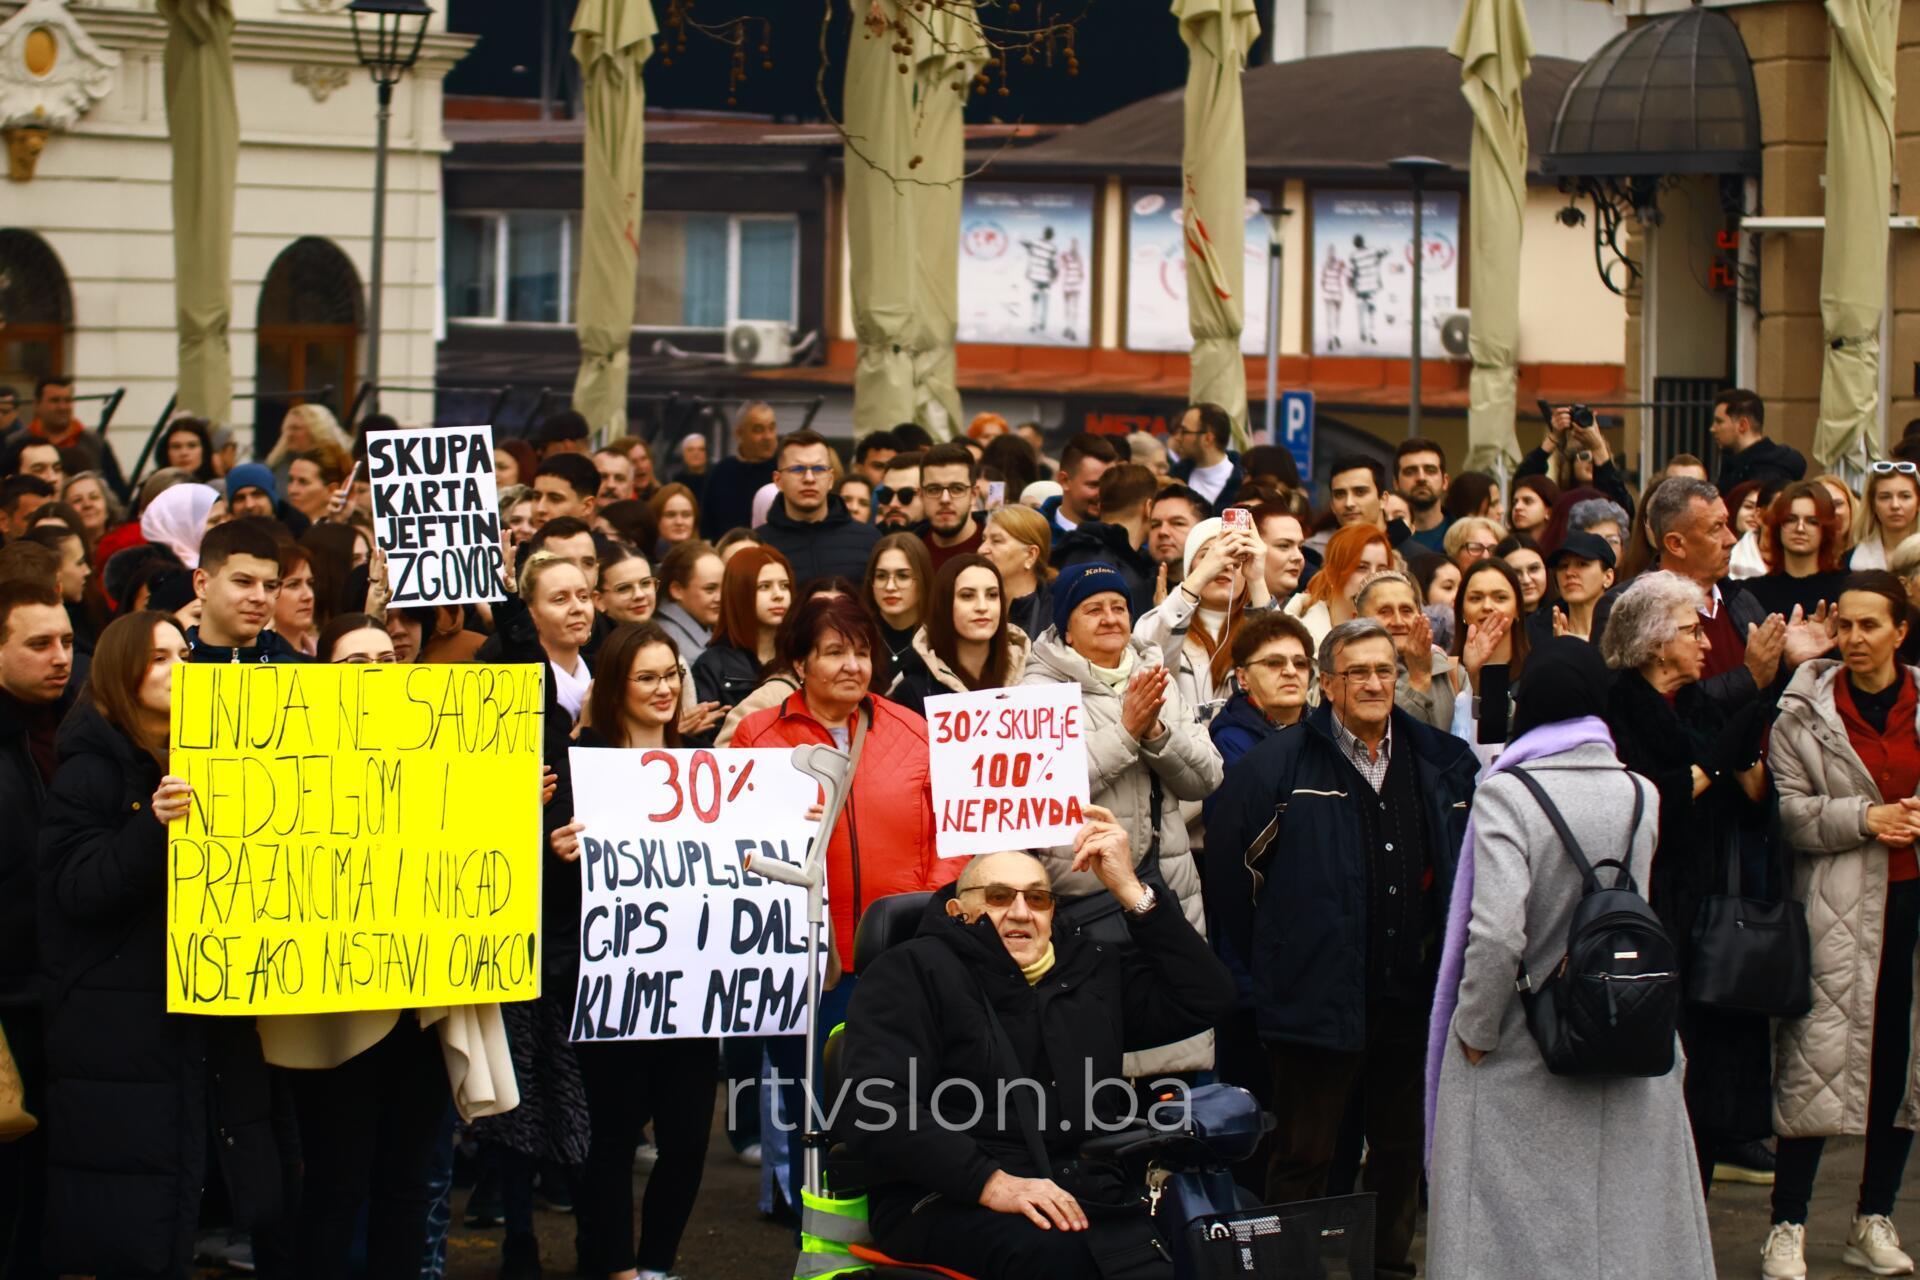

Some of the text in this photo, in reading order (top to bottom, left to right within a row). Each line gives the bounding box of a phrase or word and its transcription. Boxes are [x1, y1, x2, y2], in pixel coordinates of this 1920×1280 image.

[1287, 397, 1306, 443] P
[368, 434, 493, 478] SKUPA
[373, 477, 484, 518] KARTA
[377, 512, 500, 551] JEFTIN
[179, 665, 314, 750] LINIJA
[337, 668, 384, 751] NE
[934, 709, 990, 744] 30%
[640, 749, 755, 823] 30%
[971, 752, 1053, 788] 100%
[441, 762, 449, 831] I
[942, 795, 1084, 833] NEPRAVDA
[394, 847, 403, 917] I
[424, 848, 511, 919] NIKAD
[170, 927, 536, 1004] VIŠE AKO NASTAVI OVAKO!
